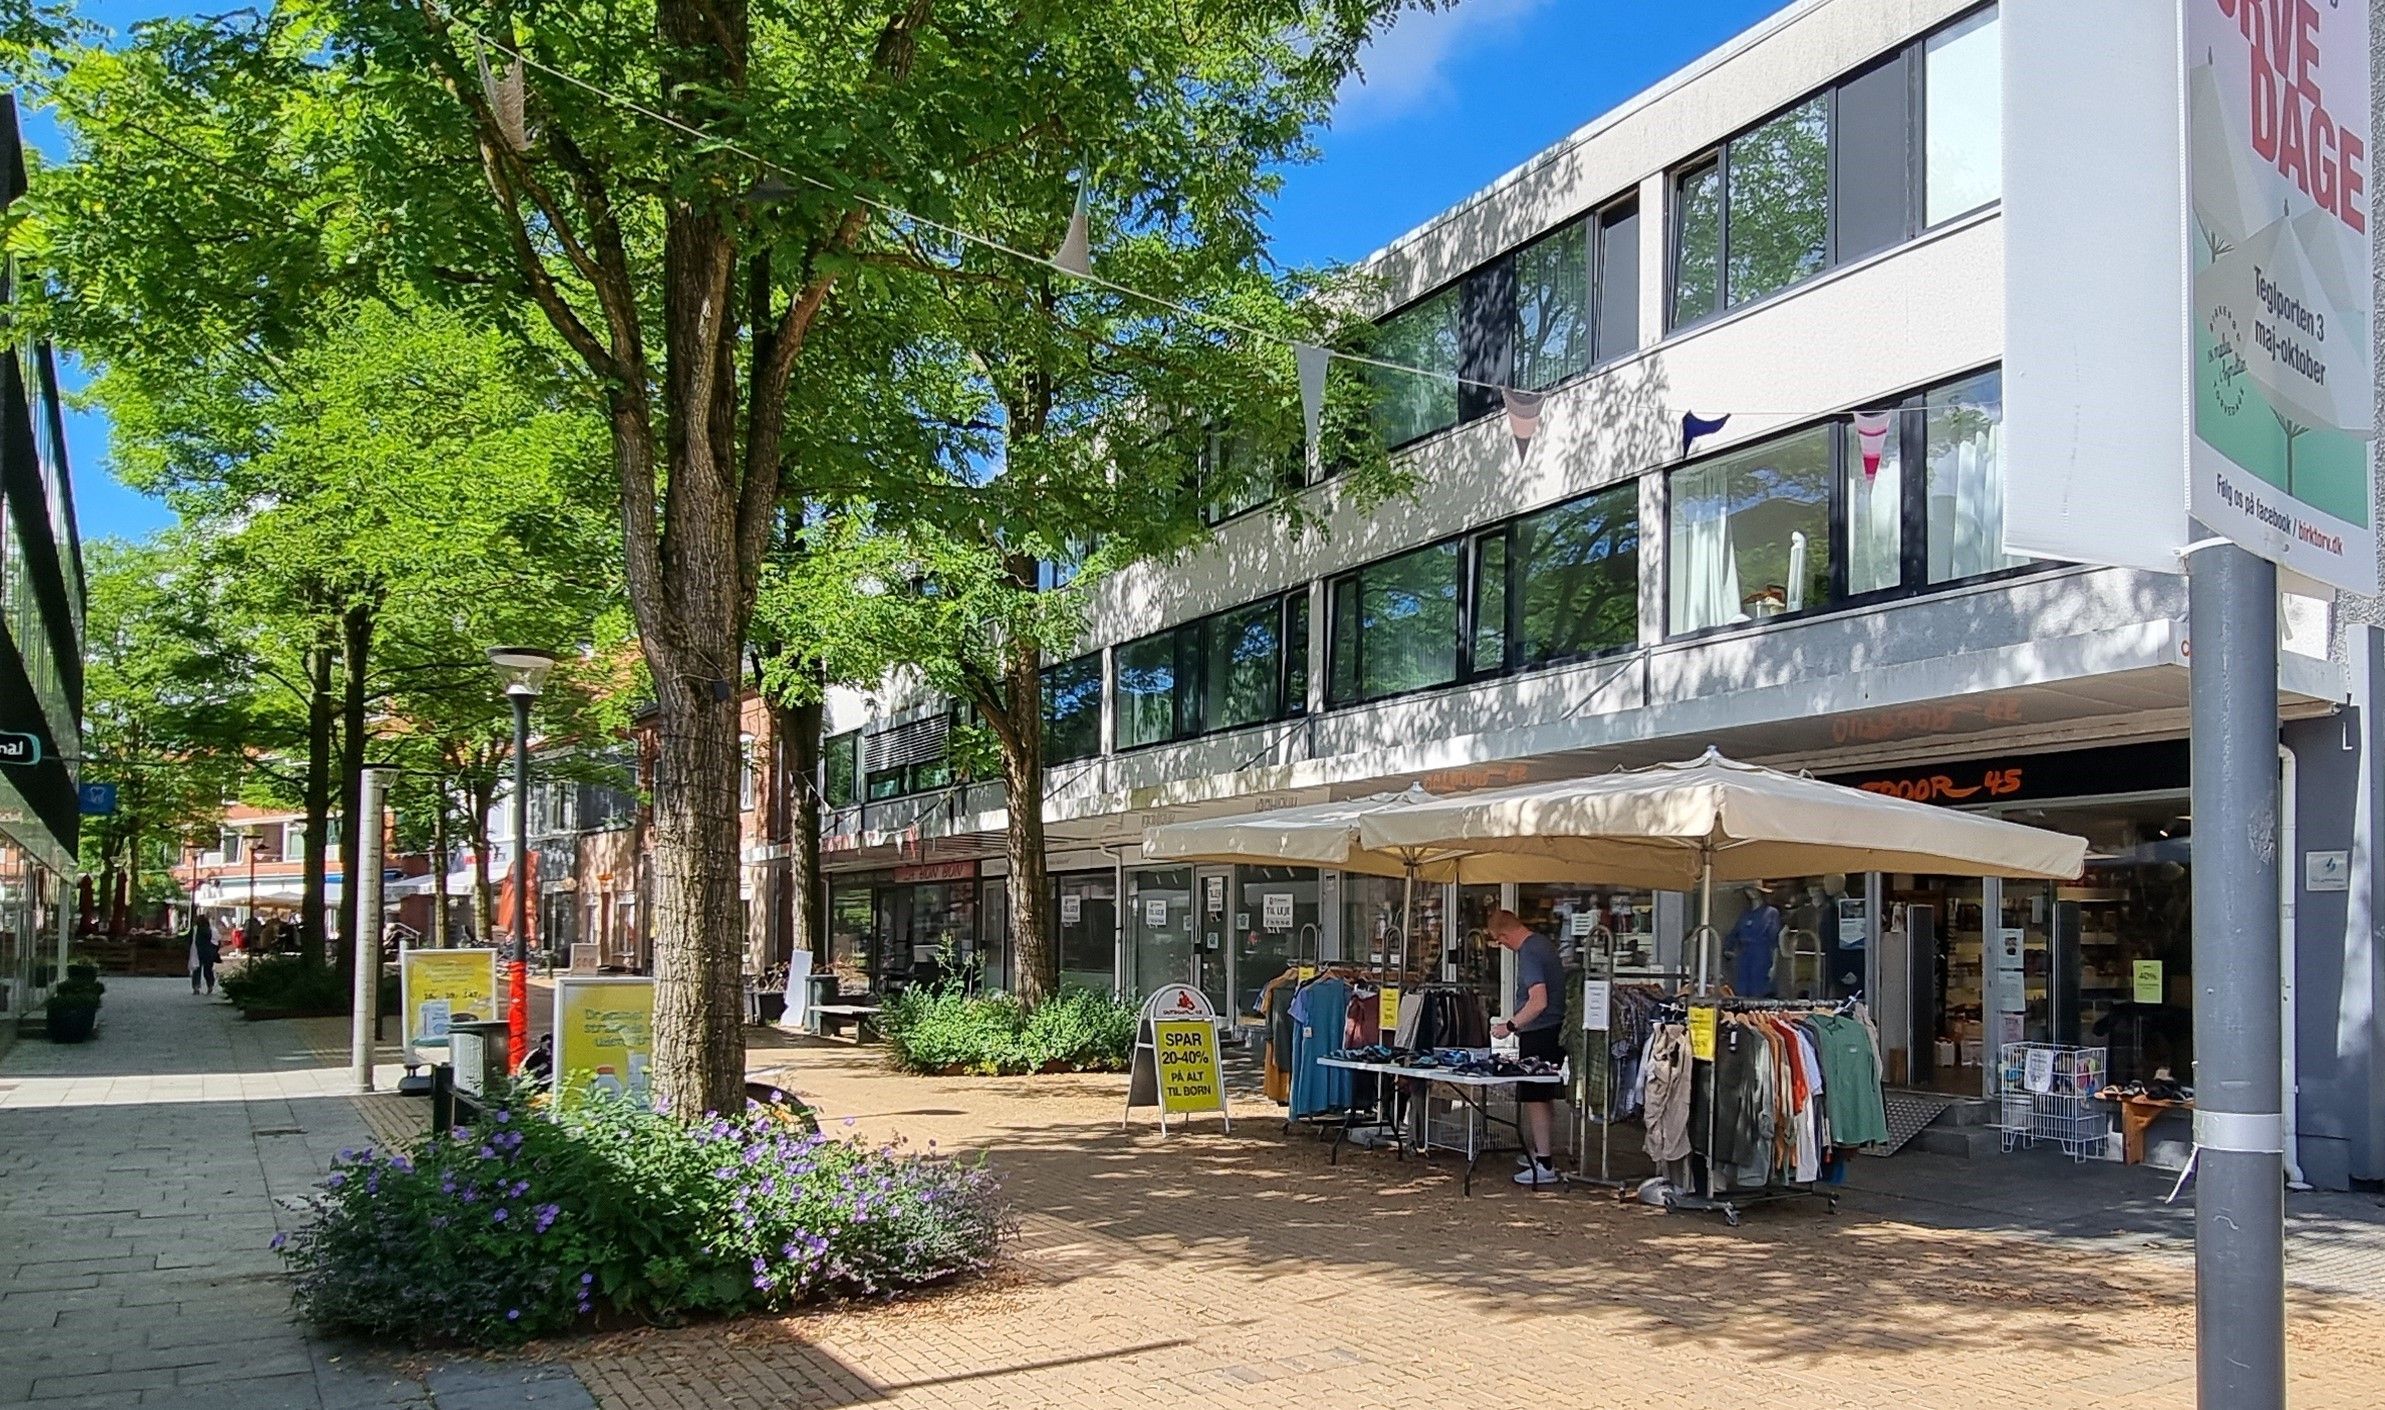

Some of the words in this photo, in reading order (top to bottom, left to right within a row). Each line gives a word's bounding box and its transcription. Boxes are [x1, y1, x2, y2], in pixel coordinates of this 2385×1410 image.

[2250, 43, 2366, 236] DAGE
[2254, 264, 2315, 337] Teglporten
[2316, 312, 2325, 343] 3
[2255, 319, 2327, 386] maj-oktober
[2216, 472, 2233, 508] Følg
[2234, 488, 2244, 509] os
[2244, 491, 2255, 517] på
[2255, 497, 2291, 536] facebook
[2298, 518, 2344, 557] birktorv.dk
[1984, 768, 2023, 796] 45
[1266, 906, 1276, 915] TIL
[1277, 906, 1290, 916] LEJE
[1165, 1032, 1202, 1047] SPAR
[1162, 1050, 1209, 1065] 20-40%
[1171, 1069, 1185, 1082] PÅ
[1187, 1071, 1204, 1082] ALT
[1167, 1086, 1182, 1096] TIL
[1184, 1085, 1211, 1097] BØRN
